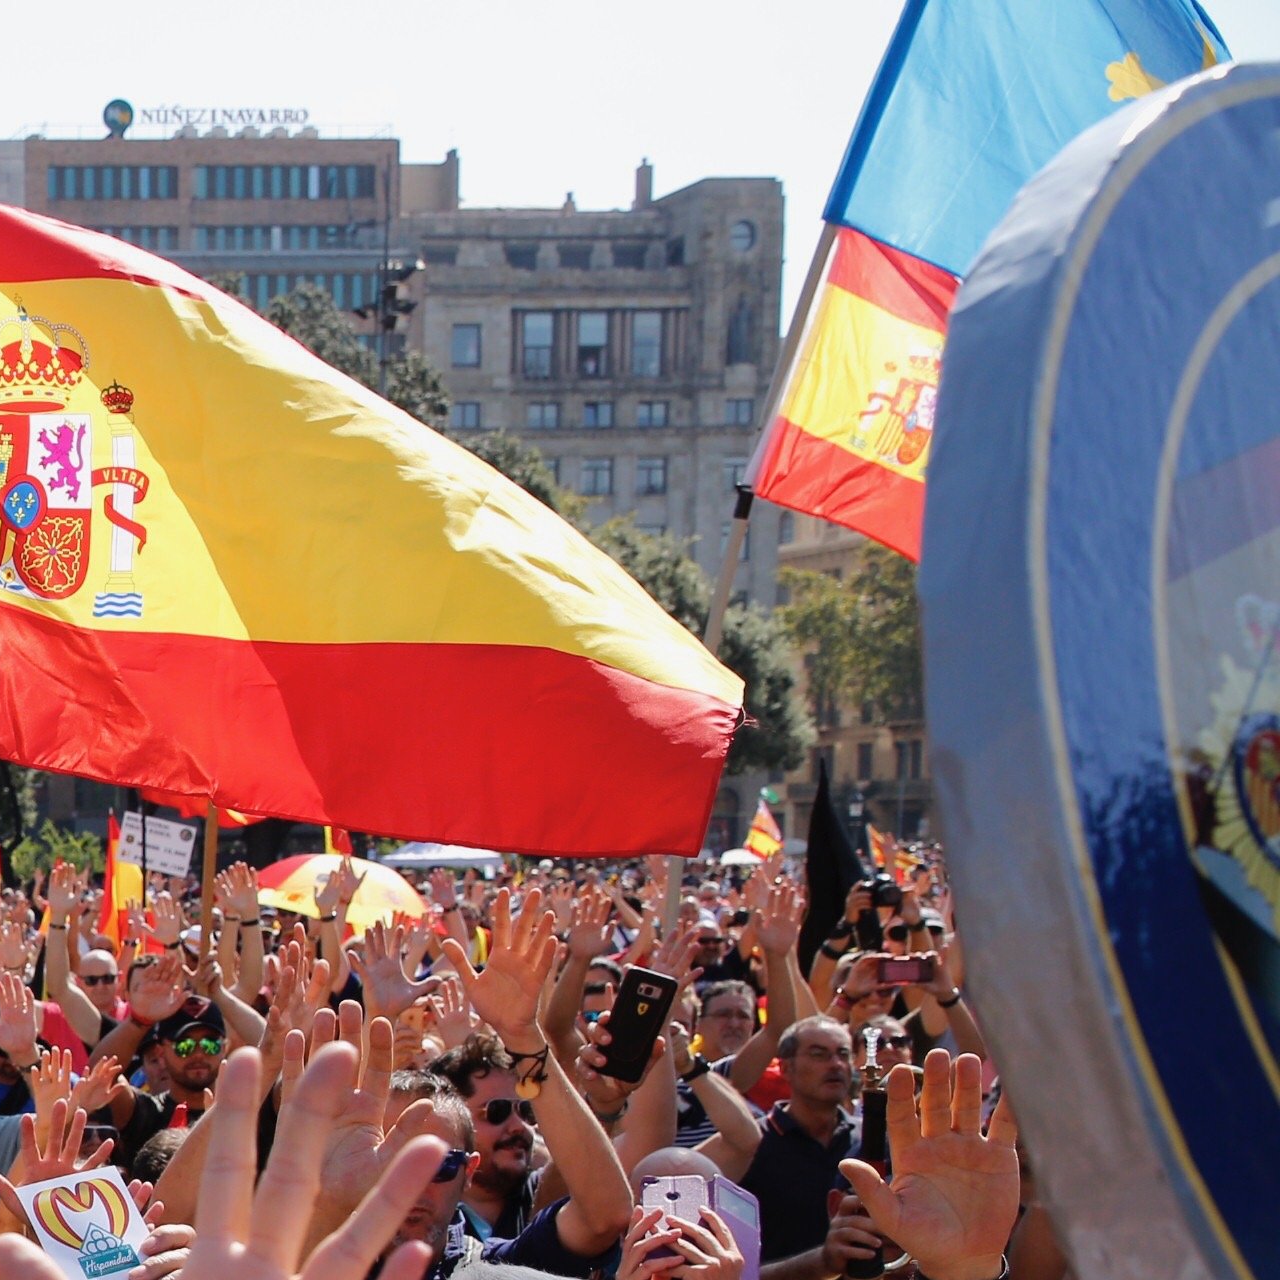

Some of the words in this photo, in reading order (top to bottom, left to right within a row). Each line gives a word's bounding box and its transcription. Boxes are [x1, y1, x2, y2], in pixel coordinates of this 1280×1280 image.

[141, 104, 204, 124] NÚÑEZ
[221, 109, 309, 125] NAVARRO
[102, 468, 146, 488] VLTRA
[85, 1249, 134, 1276] Hispanidad
